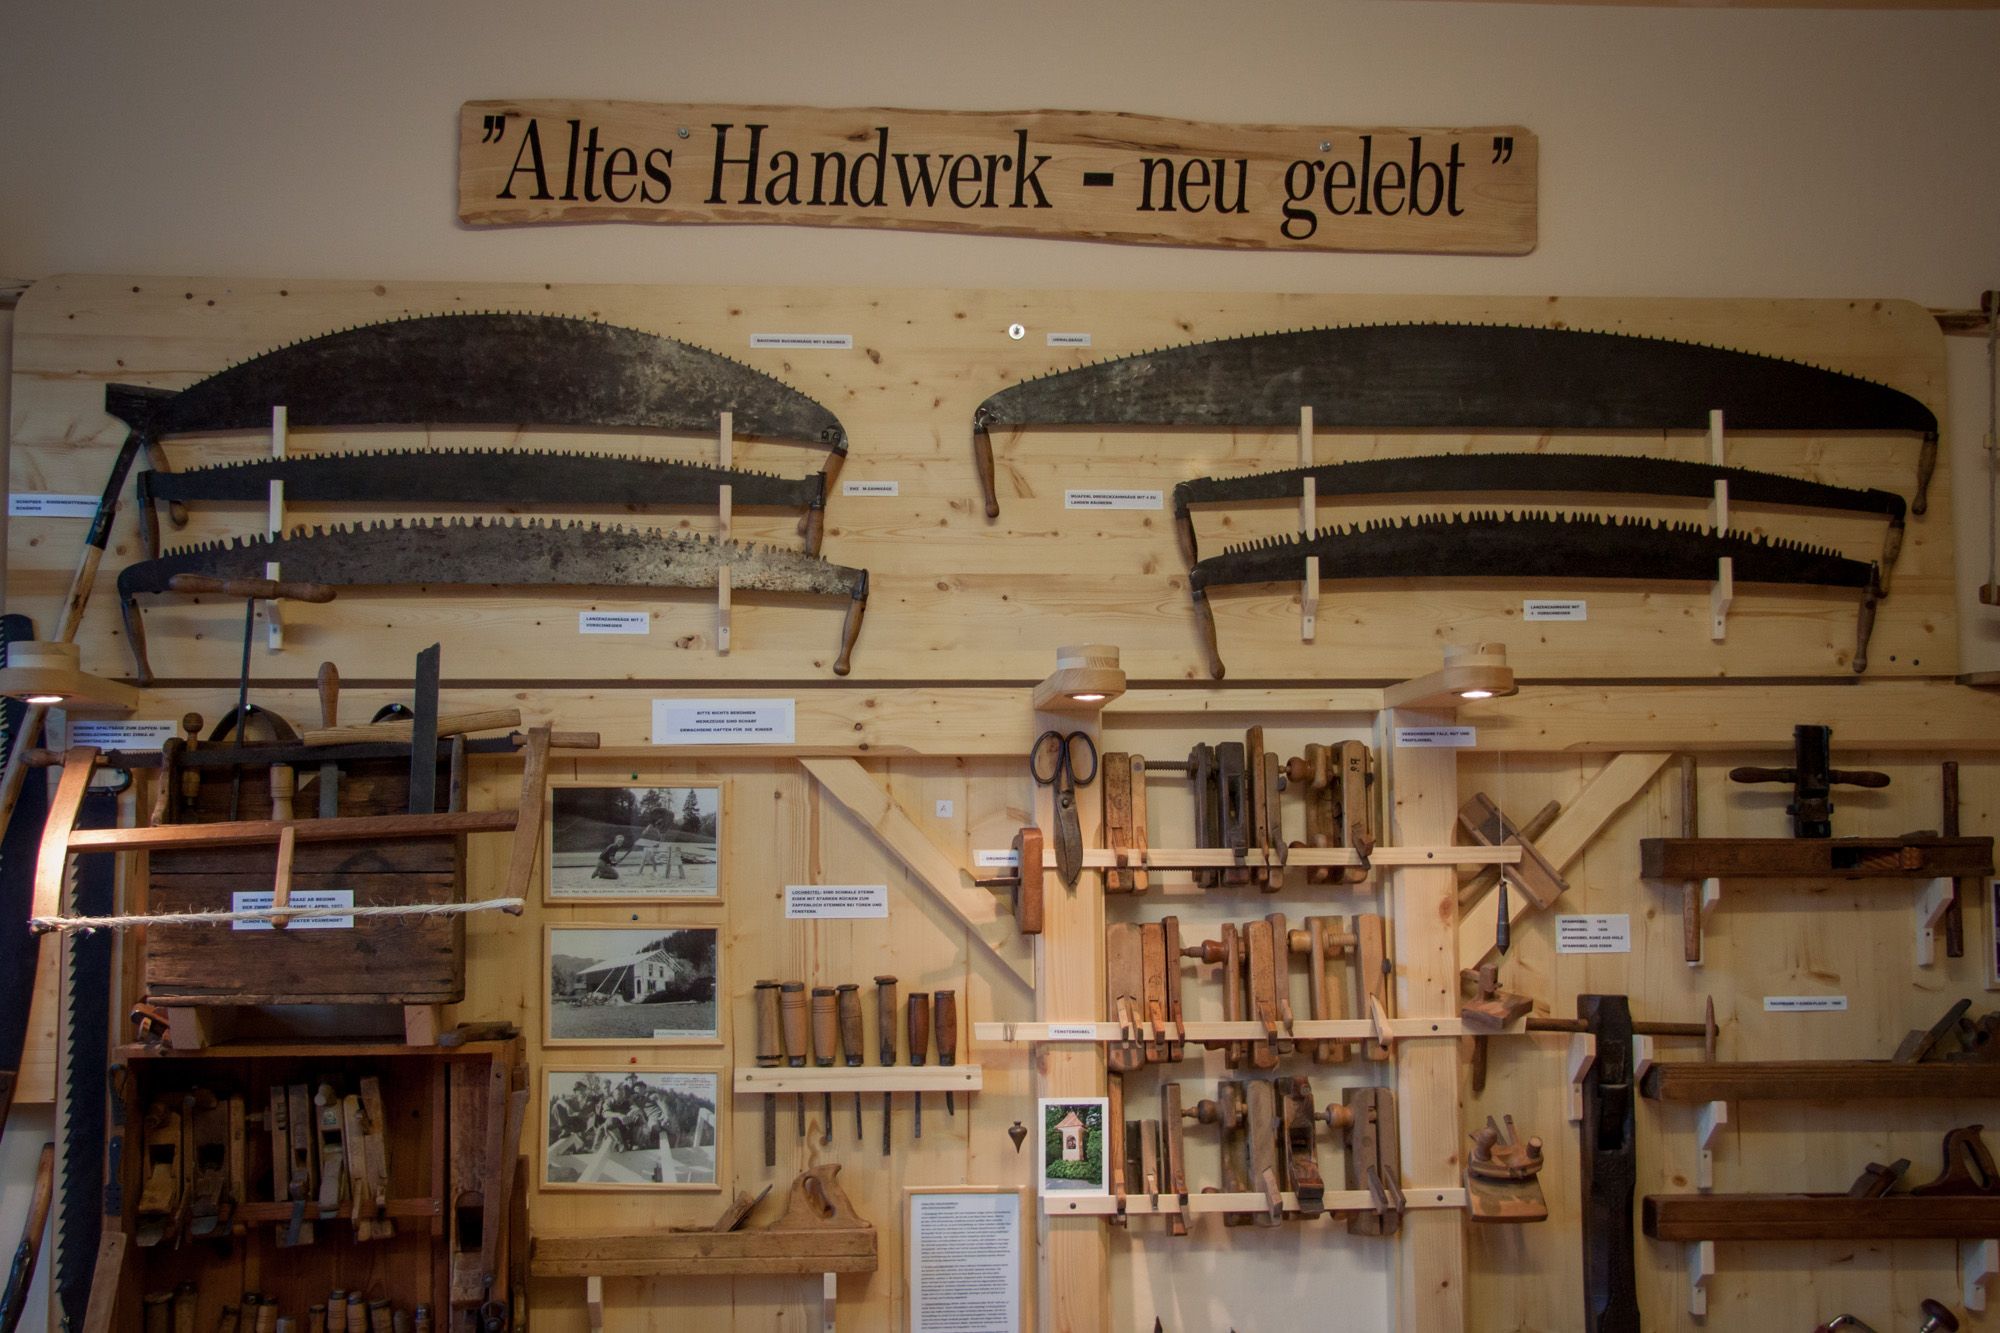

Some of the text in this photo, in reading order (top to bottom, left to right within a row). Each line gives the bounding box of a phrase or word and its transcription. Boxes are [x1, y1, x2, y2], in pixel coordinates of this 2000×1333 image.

[704, 123, 1053, 209] Handwerk
[1083, 170, 1114, 188] -
[1136, 156, 1250, 215] neu
[1280, 134, 1466, 241] gelebt
